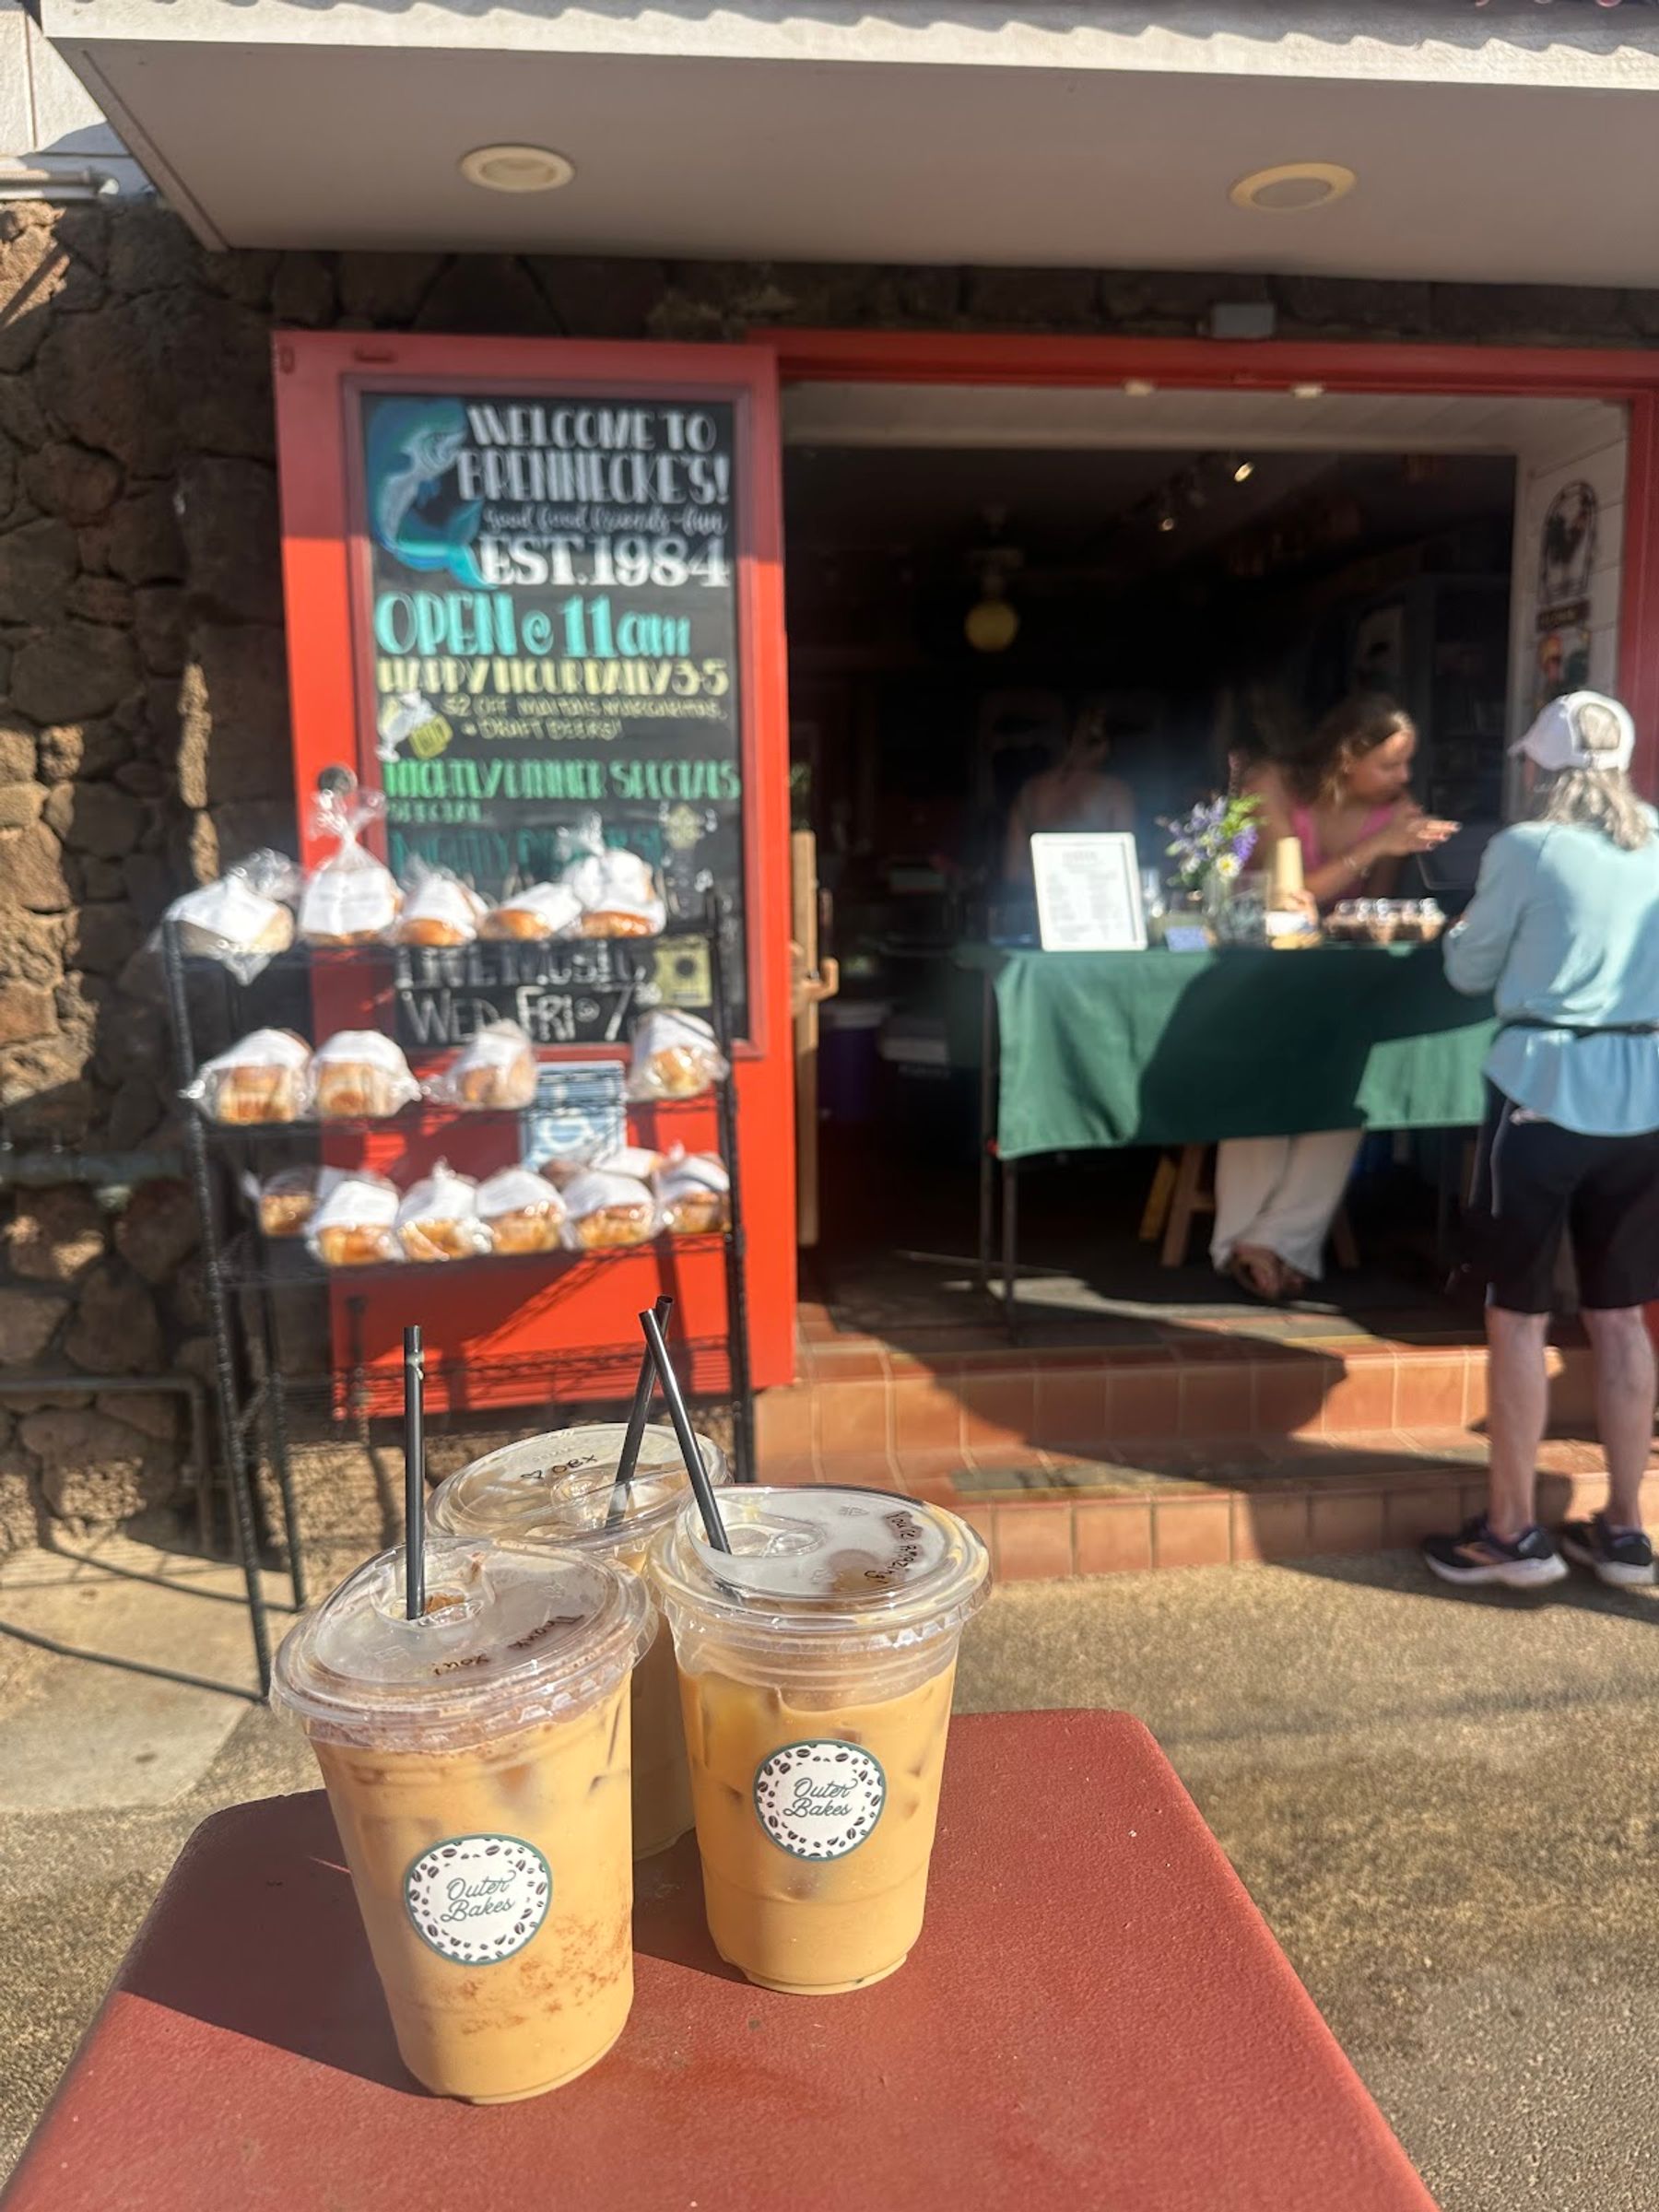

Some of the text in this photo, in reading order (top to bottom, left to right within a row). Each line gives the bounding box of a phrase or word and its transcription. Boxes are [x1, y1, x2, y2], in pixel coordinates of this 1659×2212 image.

[467, 404, 717, 452] WELCOME TO
[375, 591, 517, 655] OPEN
[672, 659, 730, 696] 3-5
[794, 1777, 858, 1798] Outer
[782, 1797, 853, 1818] Bakes
[446, 1869, 517, 1901] Outer
[440, 1897, 516, 1923] Bakes
